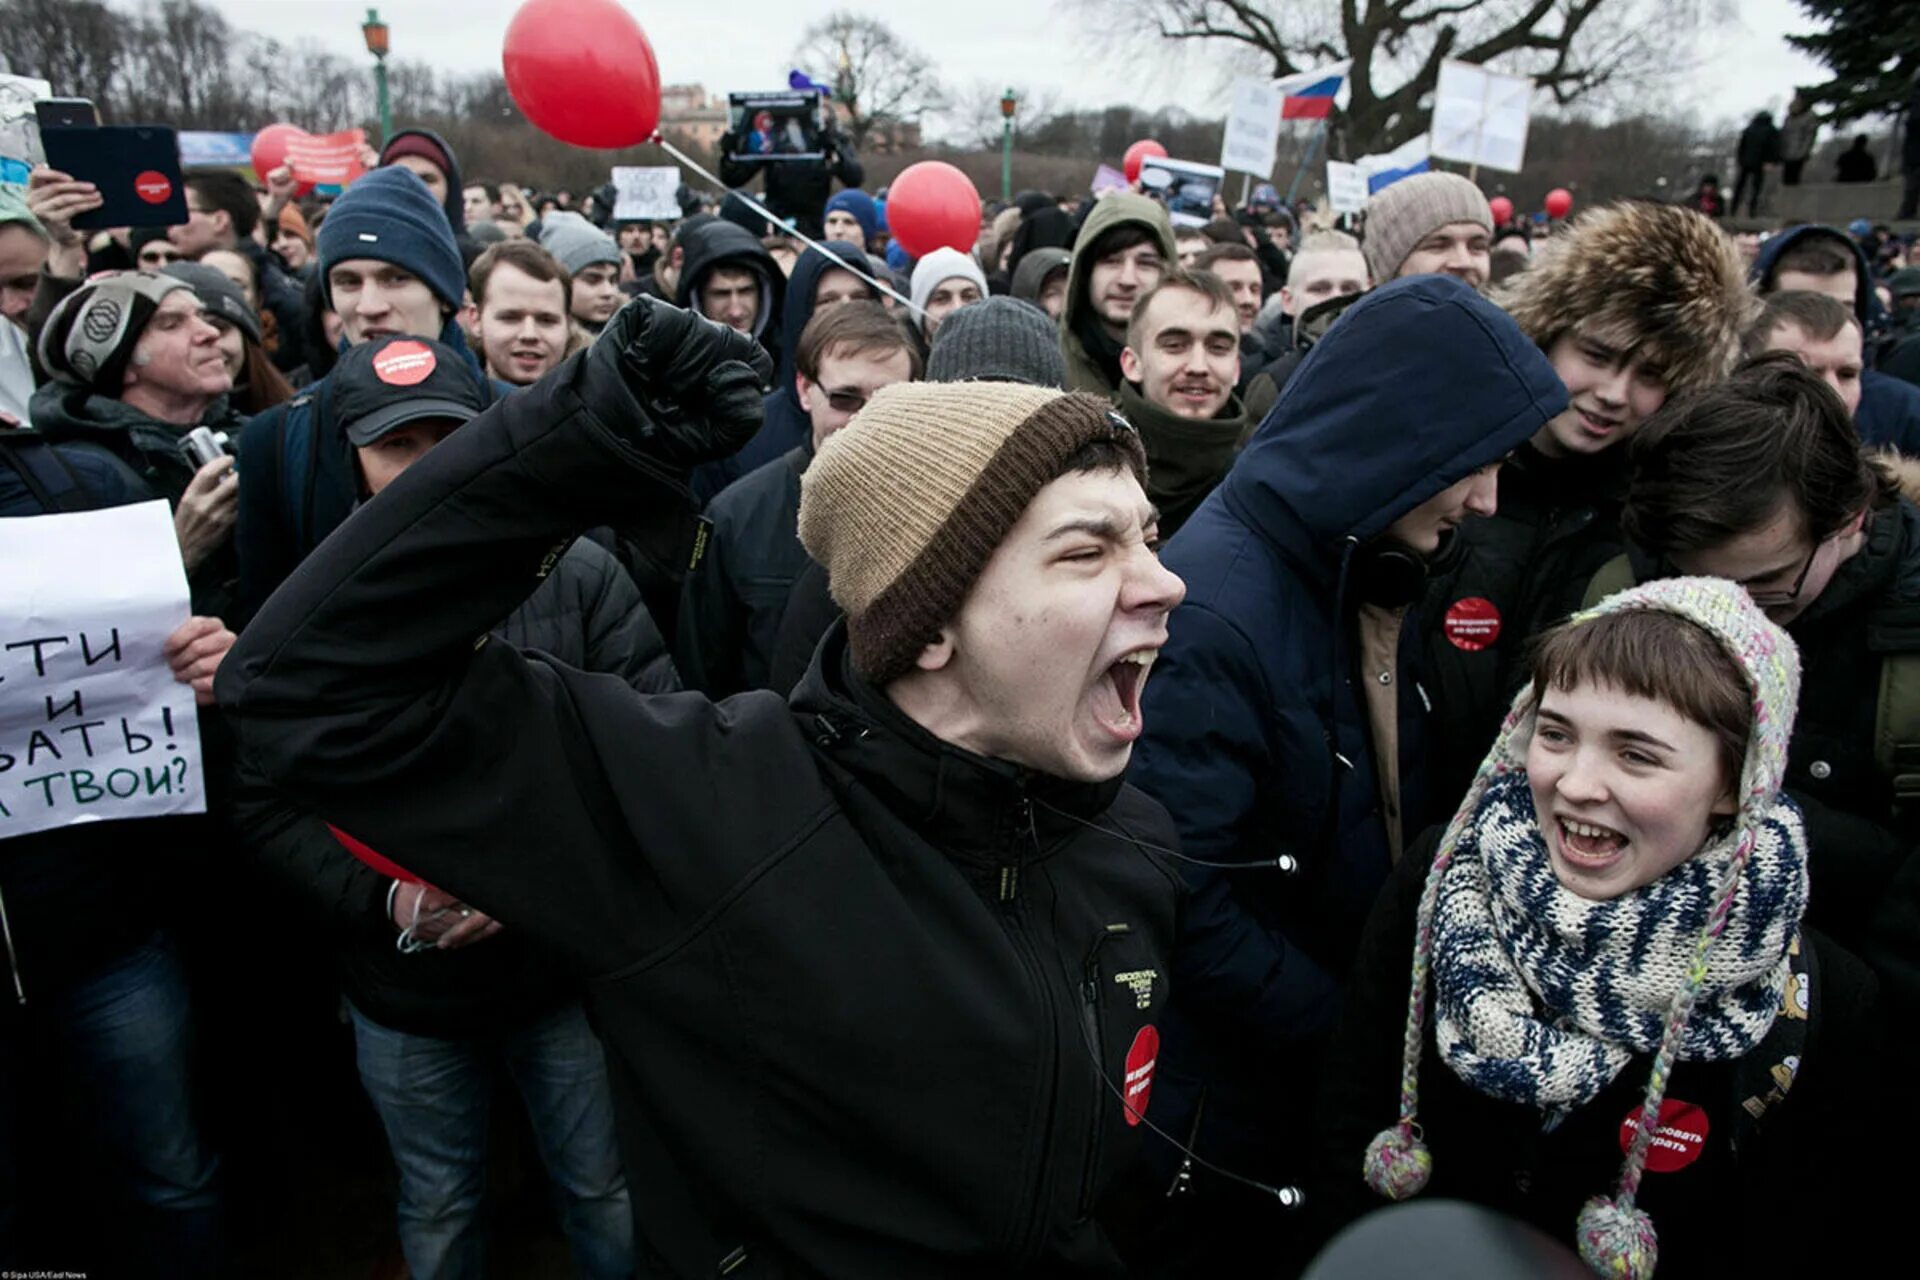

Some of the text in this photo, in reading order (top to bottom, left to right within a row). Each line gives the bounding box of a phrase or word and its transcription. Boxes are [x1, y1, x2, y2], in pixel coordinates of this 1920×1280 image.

[0, 627, 122, 684] ТИ
[45, 690, 84, 721] И
[23, 756, 187, 807] ТВОИ?
